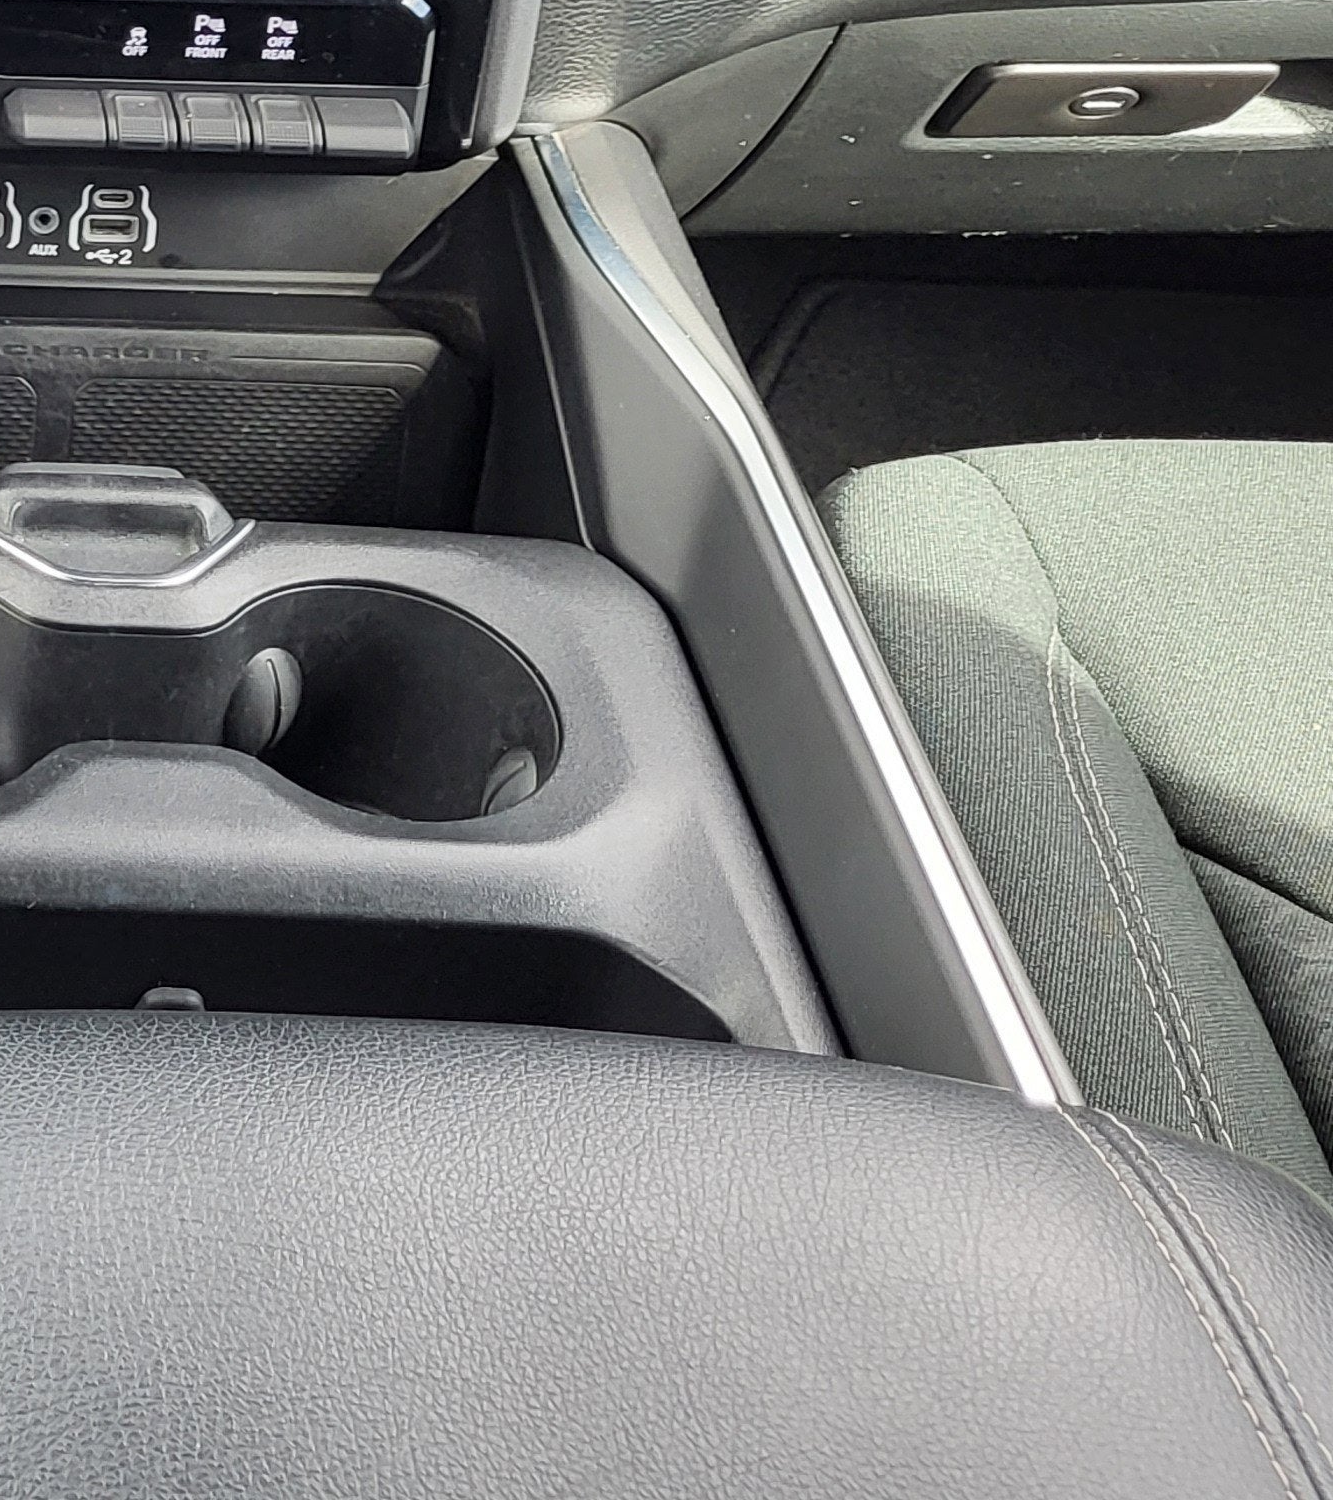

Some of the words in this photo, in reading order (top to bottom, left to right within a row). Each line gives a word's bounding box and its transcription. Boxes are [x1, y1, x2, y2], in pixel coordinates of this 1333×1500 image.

[194, 35, 221, 46] OFF
[266, 36, 293, 49] OFF
[122, 45, 148, 58] OFF
[185, 47, 227, 59] FRONT
[261, 49, 295, 62] REAR
[29, 244, 59, 256] AUX
[118, 249, 133, 265] 2
